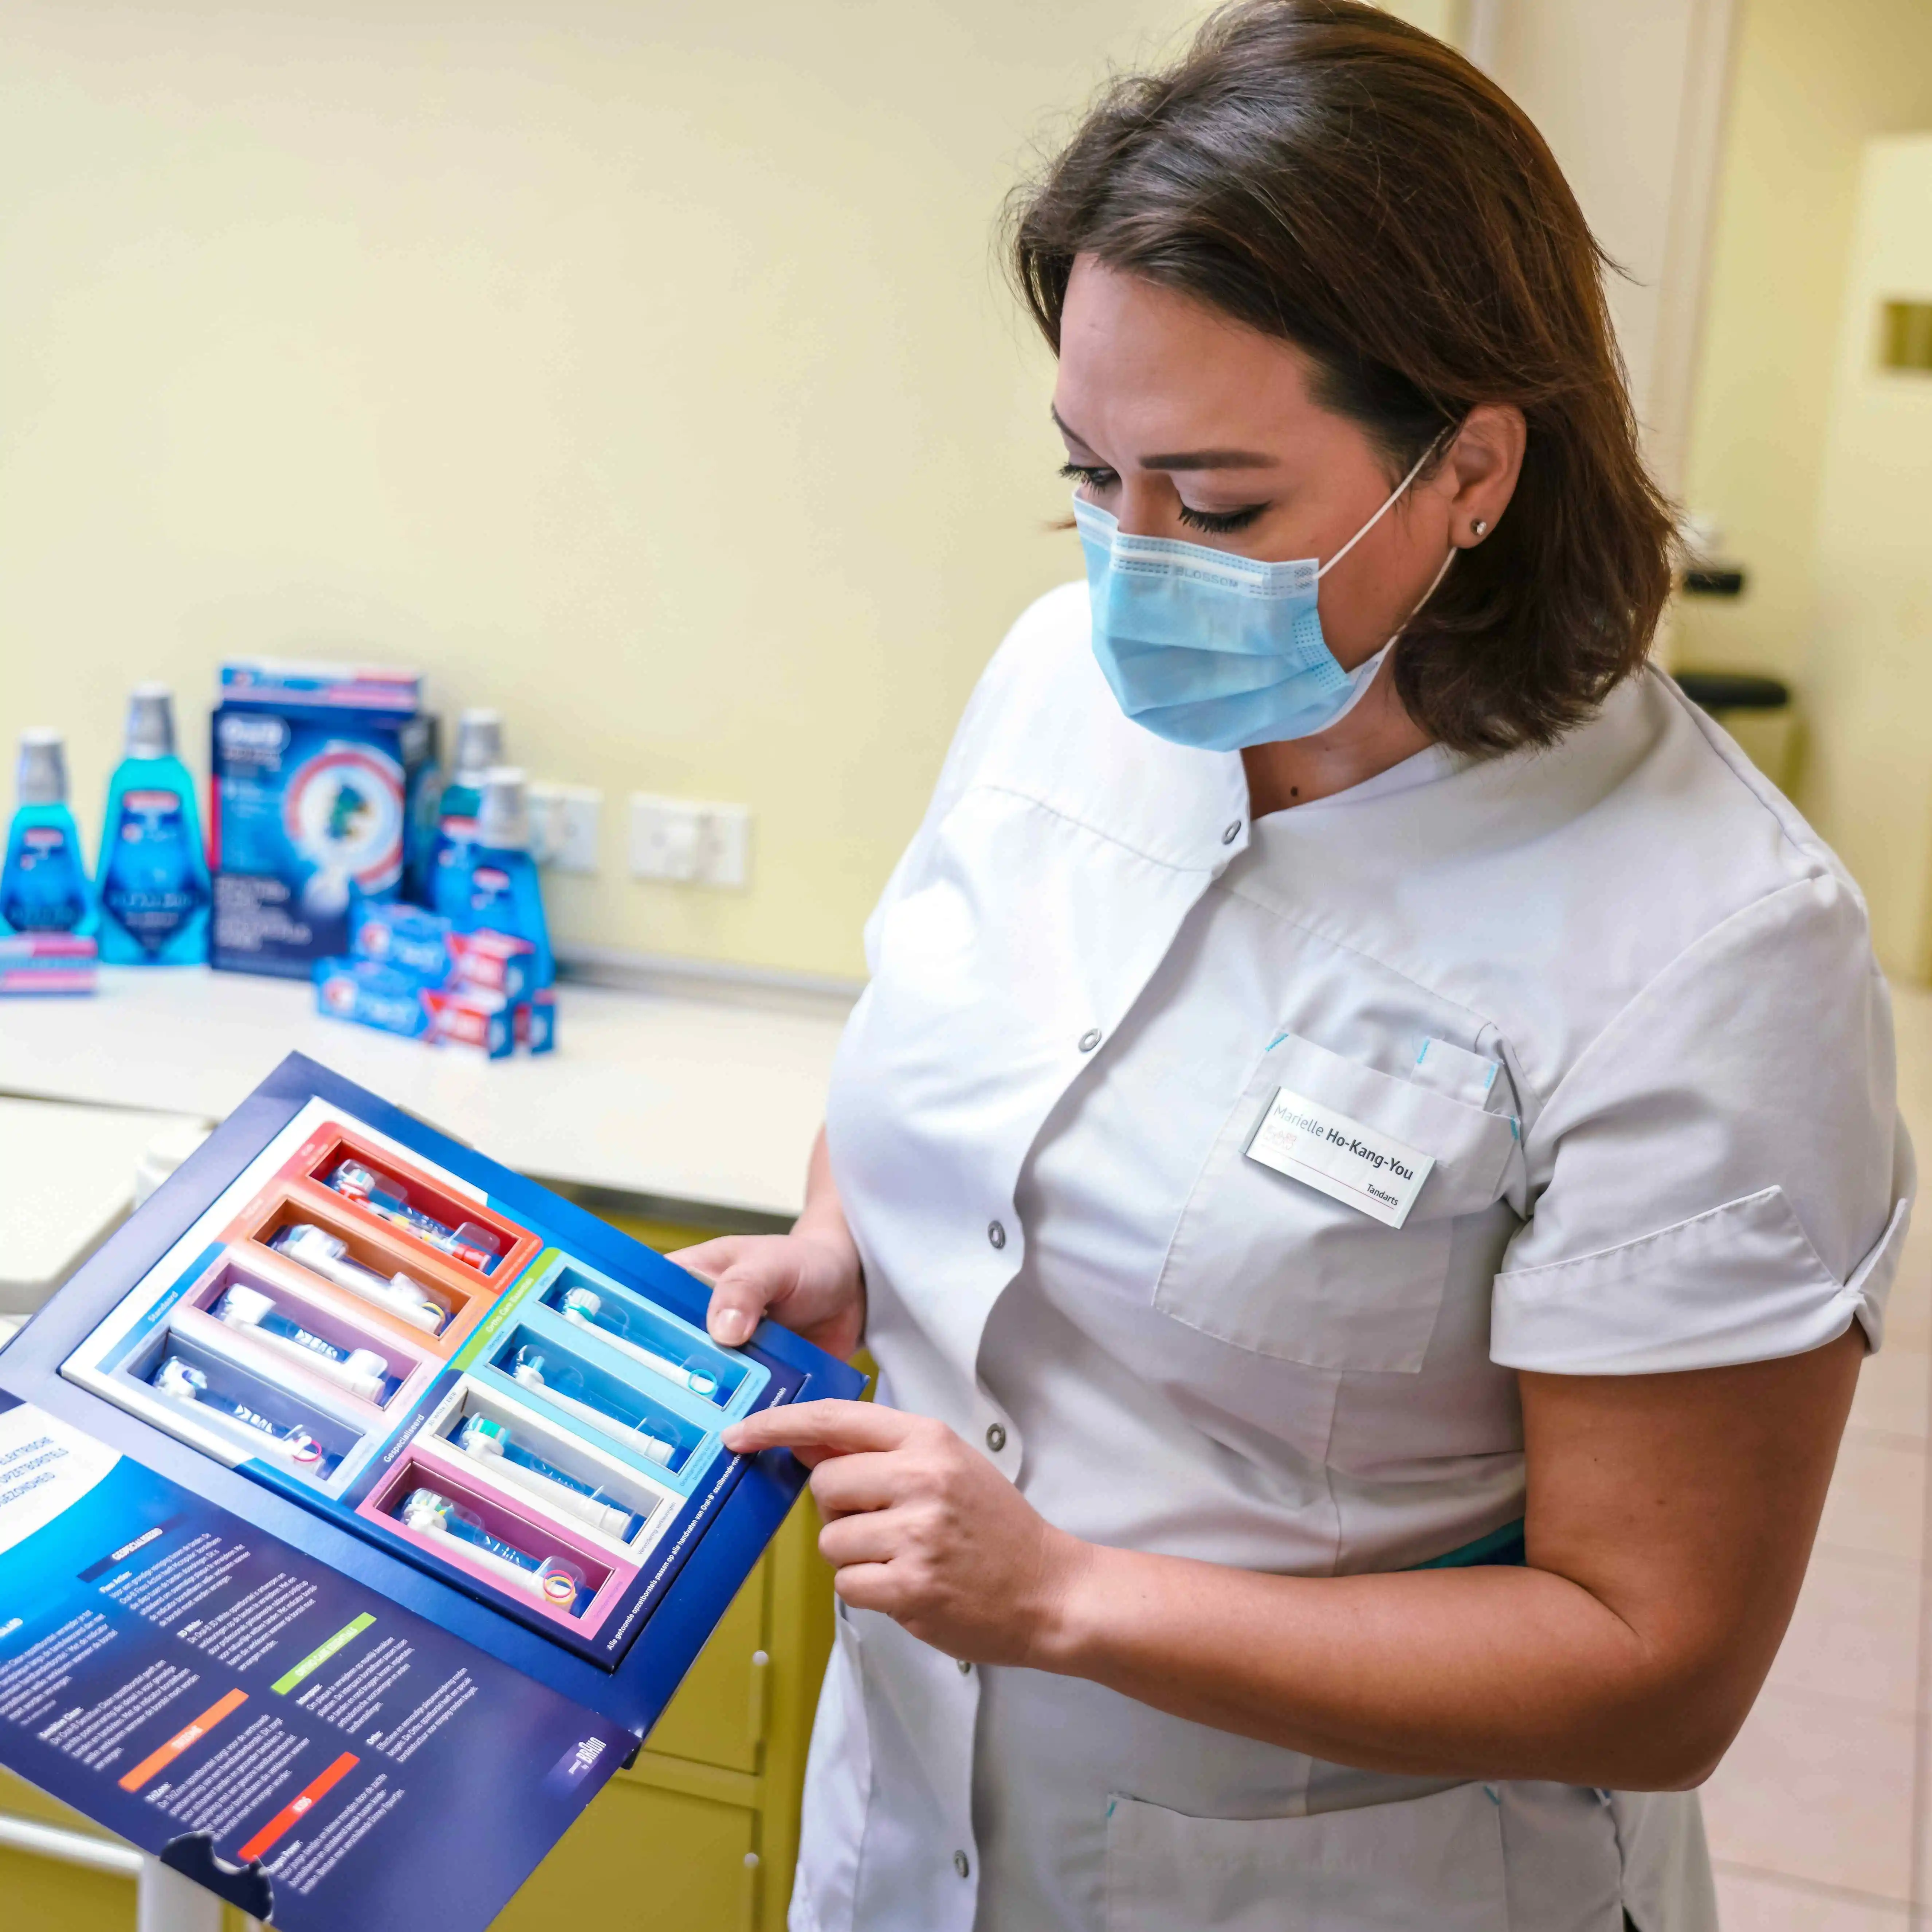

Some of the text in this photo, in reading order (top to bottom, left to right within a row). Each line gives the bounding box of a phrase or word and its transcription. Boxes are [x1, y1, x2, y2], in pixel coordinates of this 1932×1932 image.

[1175, 565, 1238, 588] BLOSSOM
[1273, 1104, 1324, 1137] Marielle
[1325, 1128, 1414, 1181] Ho-Kang-You
[1366, 1183, 1399, 1206] Tandarts
[147, 1291, 178, 1322] Standaard
[485, 1315, 503, 1332] Ortho
[499, 1301, 513, 1316] Care
[384, 1414, 424, 1462] Gespecialiseerd
[637, 1529, 658, 1554] Verwijdering
[606, 1638, 617, 1650] Alle
[614, 1613, 635, 1640] getoonde
[632, 1579, 657, 1614] opzetborstels
[654, 1562, 669, 1580] passen
[666, 1554, 675, 1562] op
[671, 1544, 681, 1555] alle
[676, 1519, 698, 1545] handvaten
[694, 1510, 704, 1520] van
[576, 1737, 606, 1763] BRAUN
[292, 1796, 312, 1813] KIDS
[267, 1854, 287, 1873] Stages
